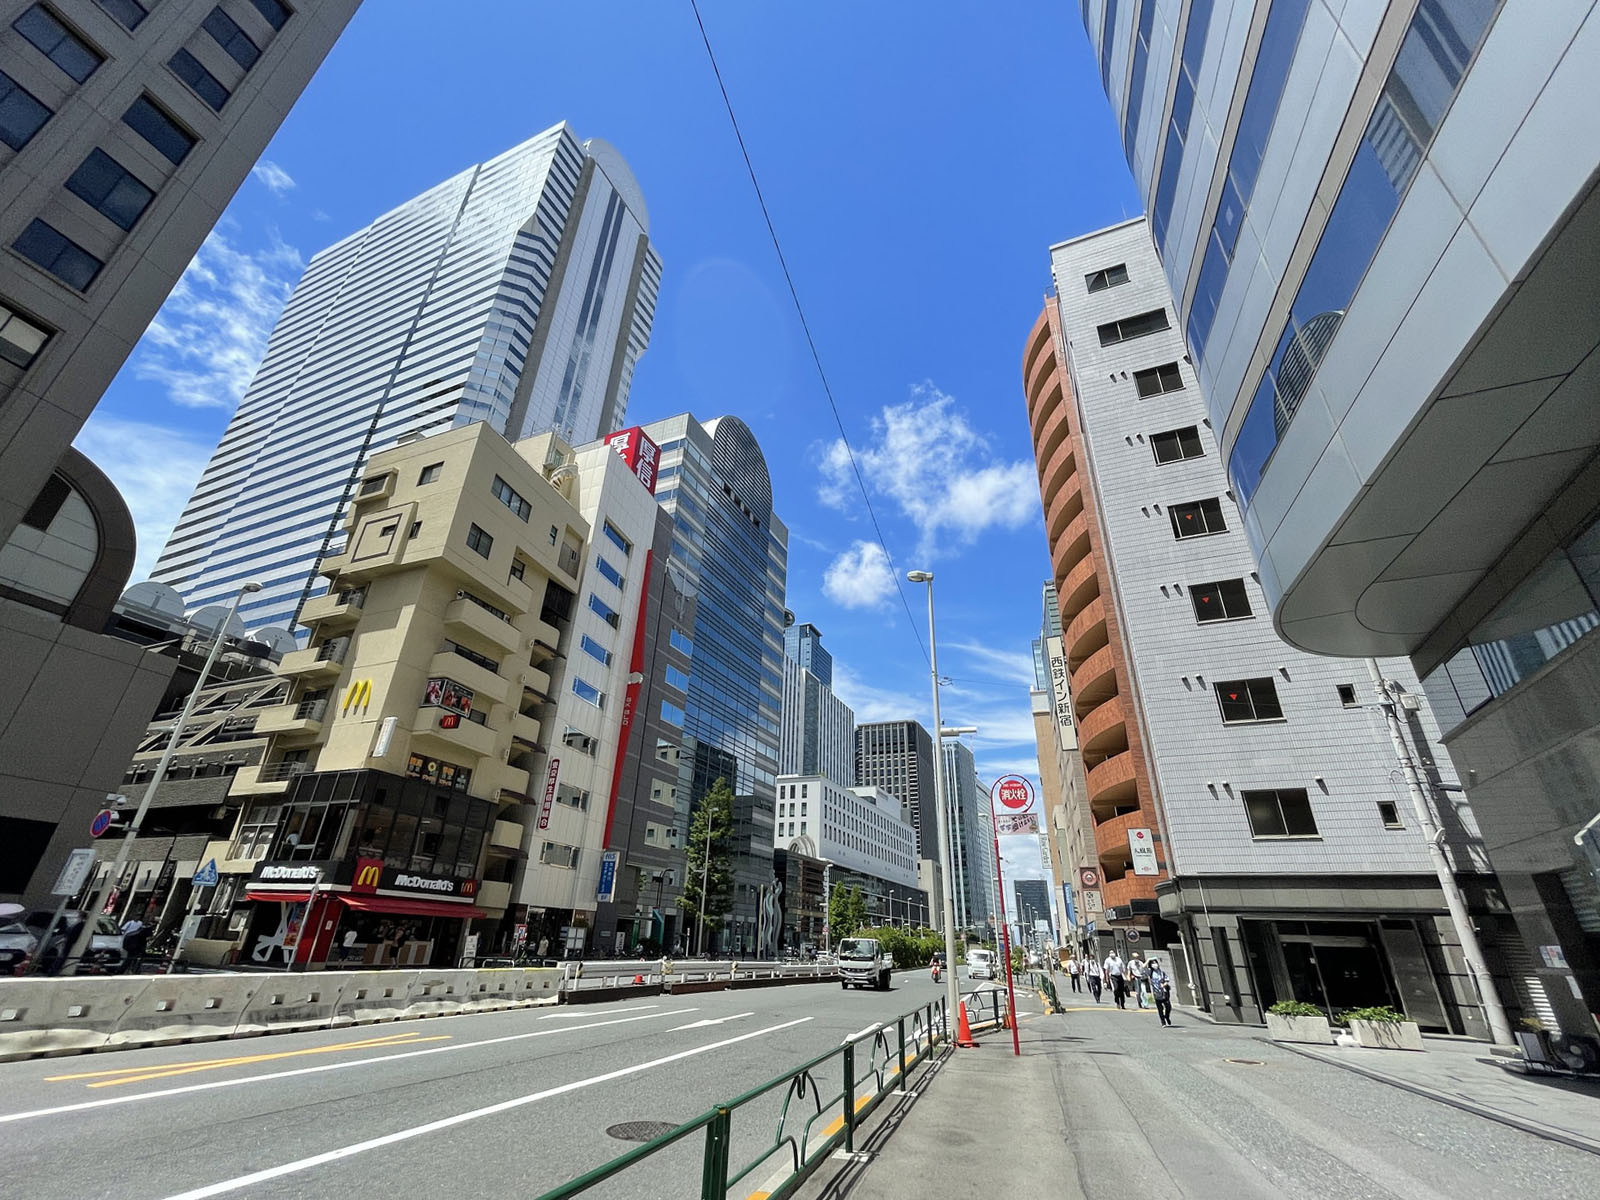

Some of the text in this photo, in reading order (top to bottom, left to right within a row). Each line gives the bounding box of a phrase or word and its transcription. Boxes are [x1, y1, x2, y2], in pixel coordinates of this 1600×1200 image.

[610, 432, 631, 460] 厚
[636, 436, 656, 488] 厚信
[1051, 656, 1072, 727] 西鉄イン新宿
[1001, 788, 1026, 800] 消火栓
[260, 865, 319, 880] McDonald's
[394, 874, 454, 892] McDonald's
